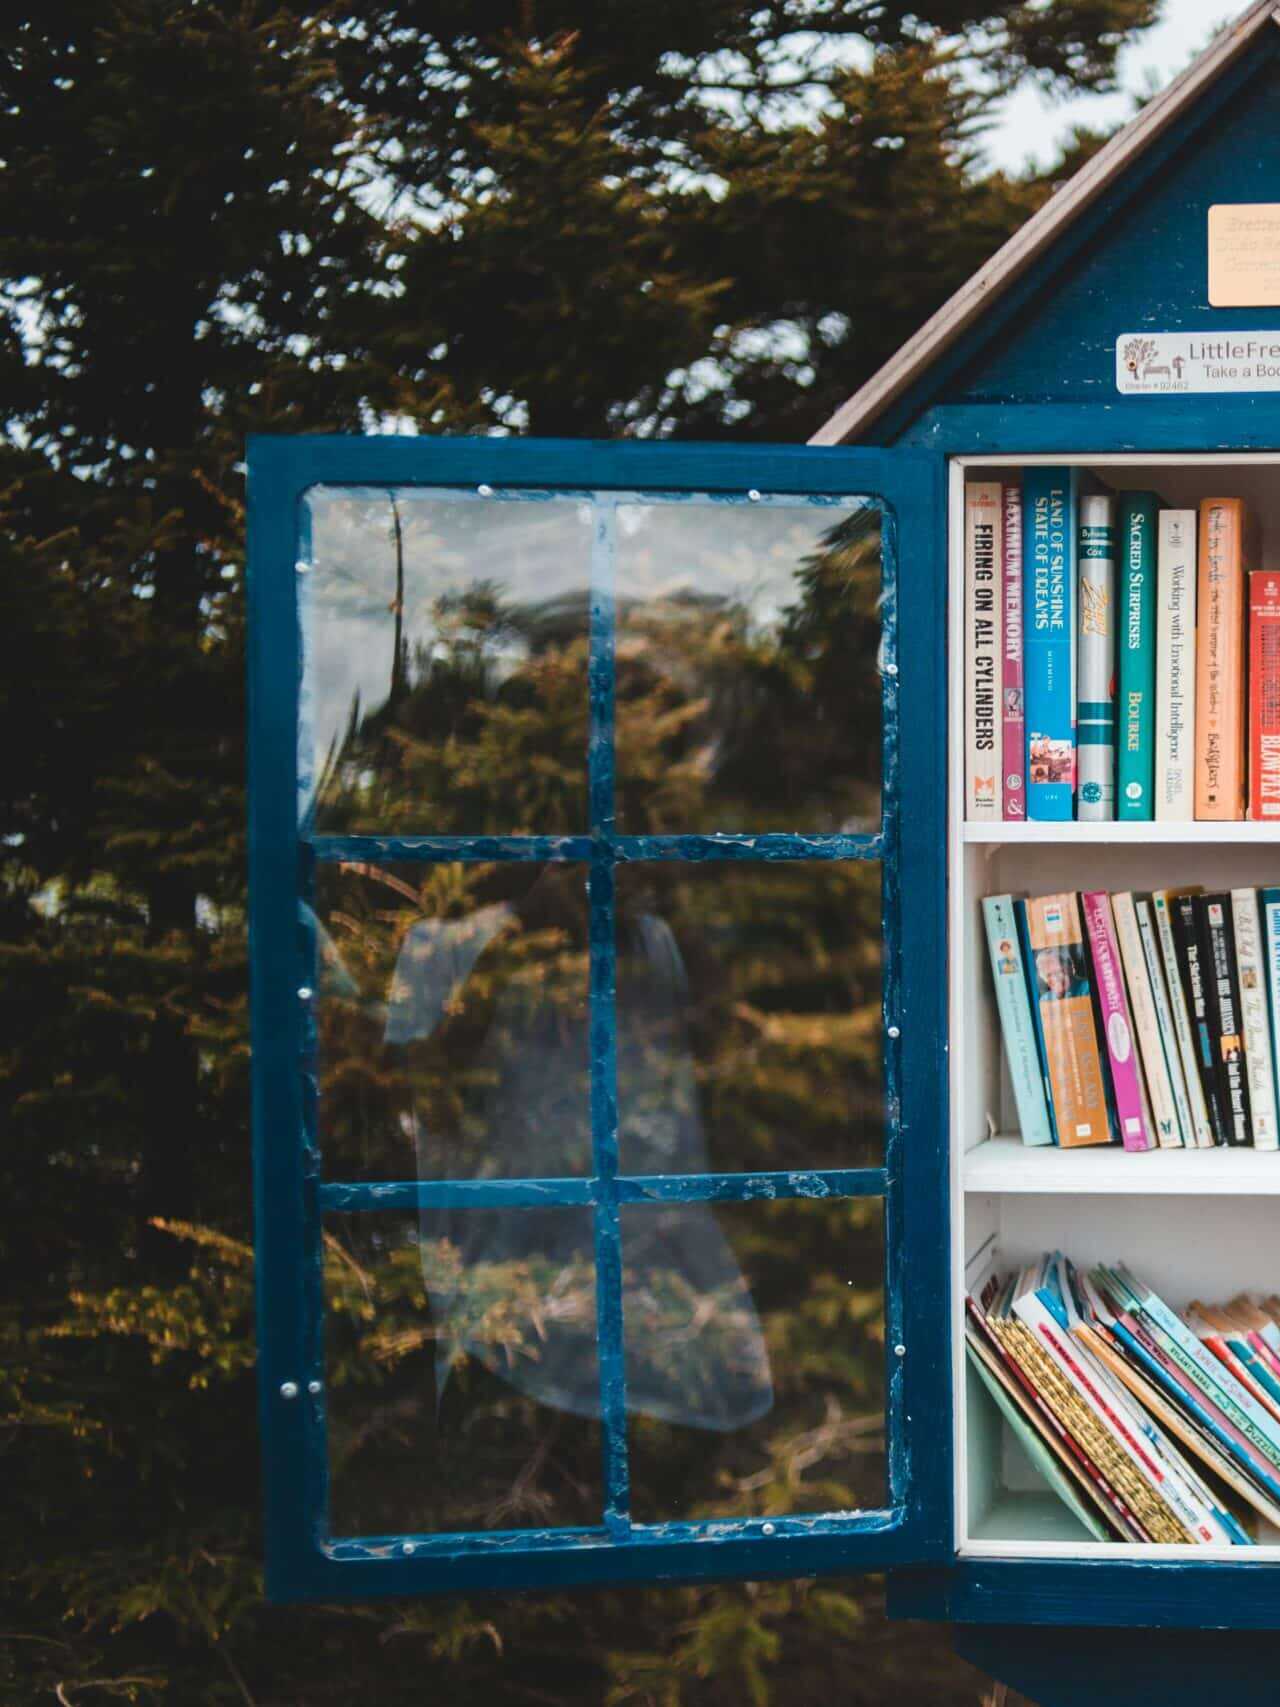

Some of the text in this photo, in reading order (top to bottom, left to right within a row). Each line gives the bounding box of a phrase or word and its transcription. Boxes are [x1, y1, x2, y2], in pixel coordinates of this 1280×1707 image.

[1203, 365, 1239, 378] Take
[1243, 367, 1252, 377] a
[975, 524, 994, 582] FIRING
[1006, 488, 1021, 663] MAXIMUM MEMORY
[1035, 497, 1048, 631] STATE OF DREAMS
[1050, 490, 1064, 633] LAND OF SUNSHINE
[1129, 513, 1144, 649] SACRED SURPRISES
[975, 588, 994, 612] ON
[975, 618, 994, 649] ALL
[1166, 565, 1184, 760] Working with Emotional Intelligence
[975, 656, 994, 751] CYLINDERS
[1128, 692, 1143, 752] BOURKE
[1188, 944, 1198, 961] The
[1189, 962, 1202, 998] Skeleton
[1134, 1328, 1170, 1365] Snow White
